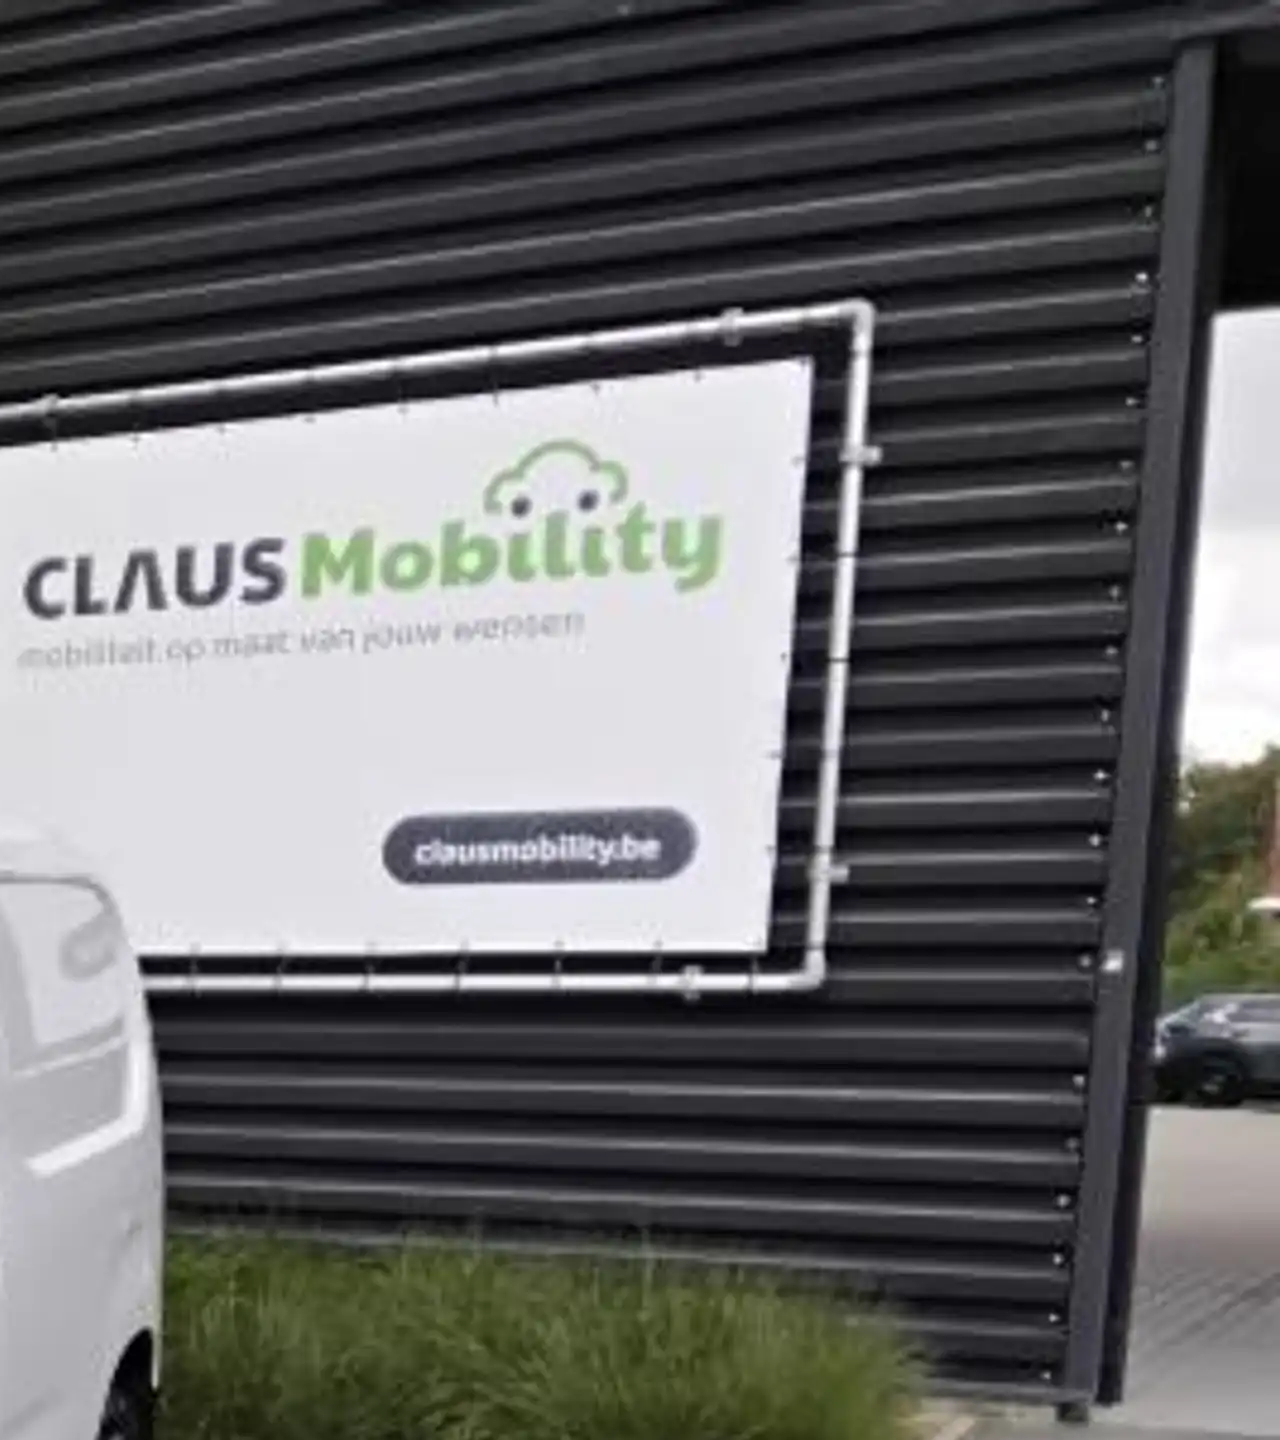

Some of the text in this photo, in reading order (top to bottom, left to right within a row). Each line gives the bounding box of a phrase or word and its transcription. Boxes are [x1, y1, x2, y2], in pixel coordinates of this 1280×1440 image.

[23, 500, 724, 619] CLAUS Mobility
[166, 637, 207, 666] op
[213, 628, 289, 657] maat
[300, 627, 355, 652] van
[413, 831, 663, 866] clausmobility.be
